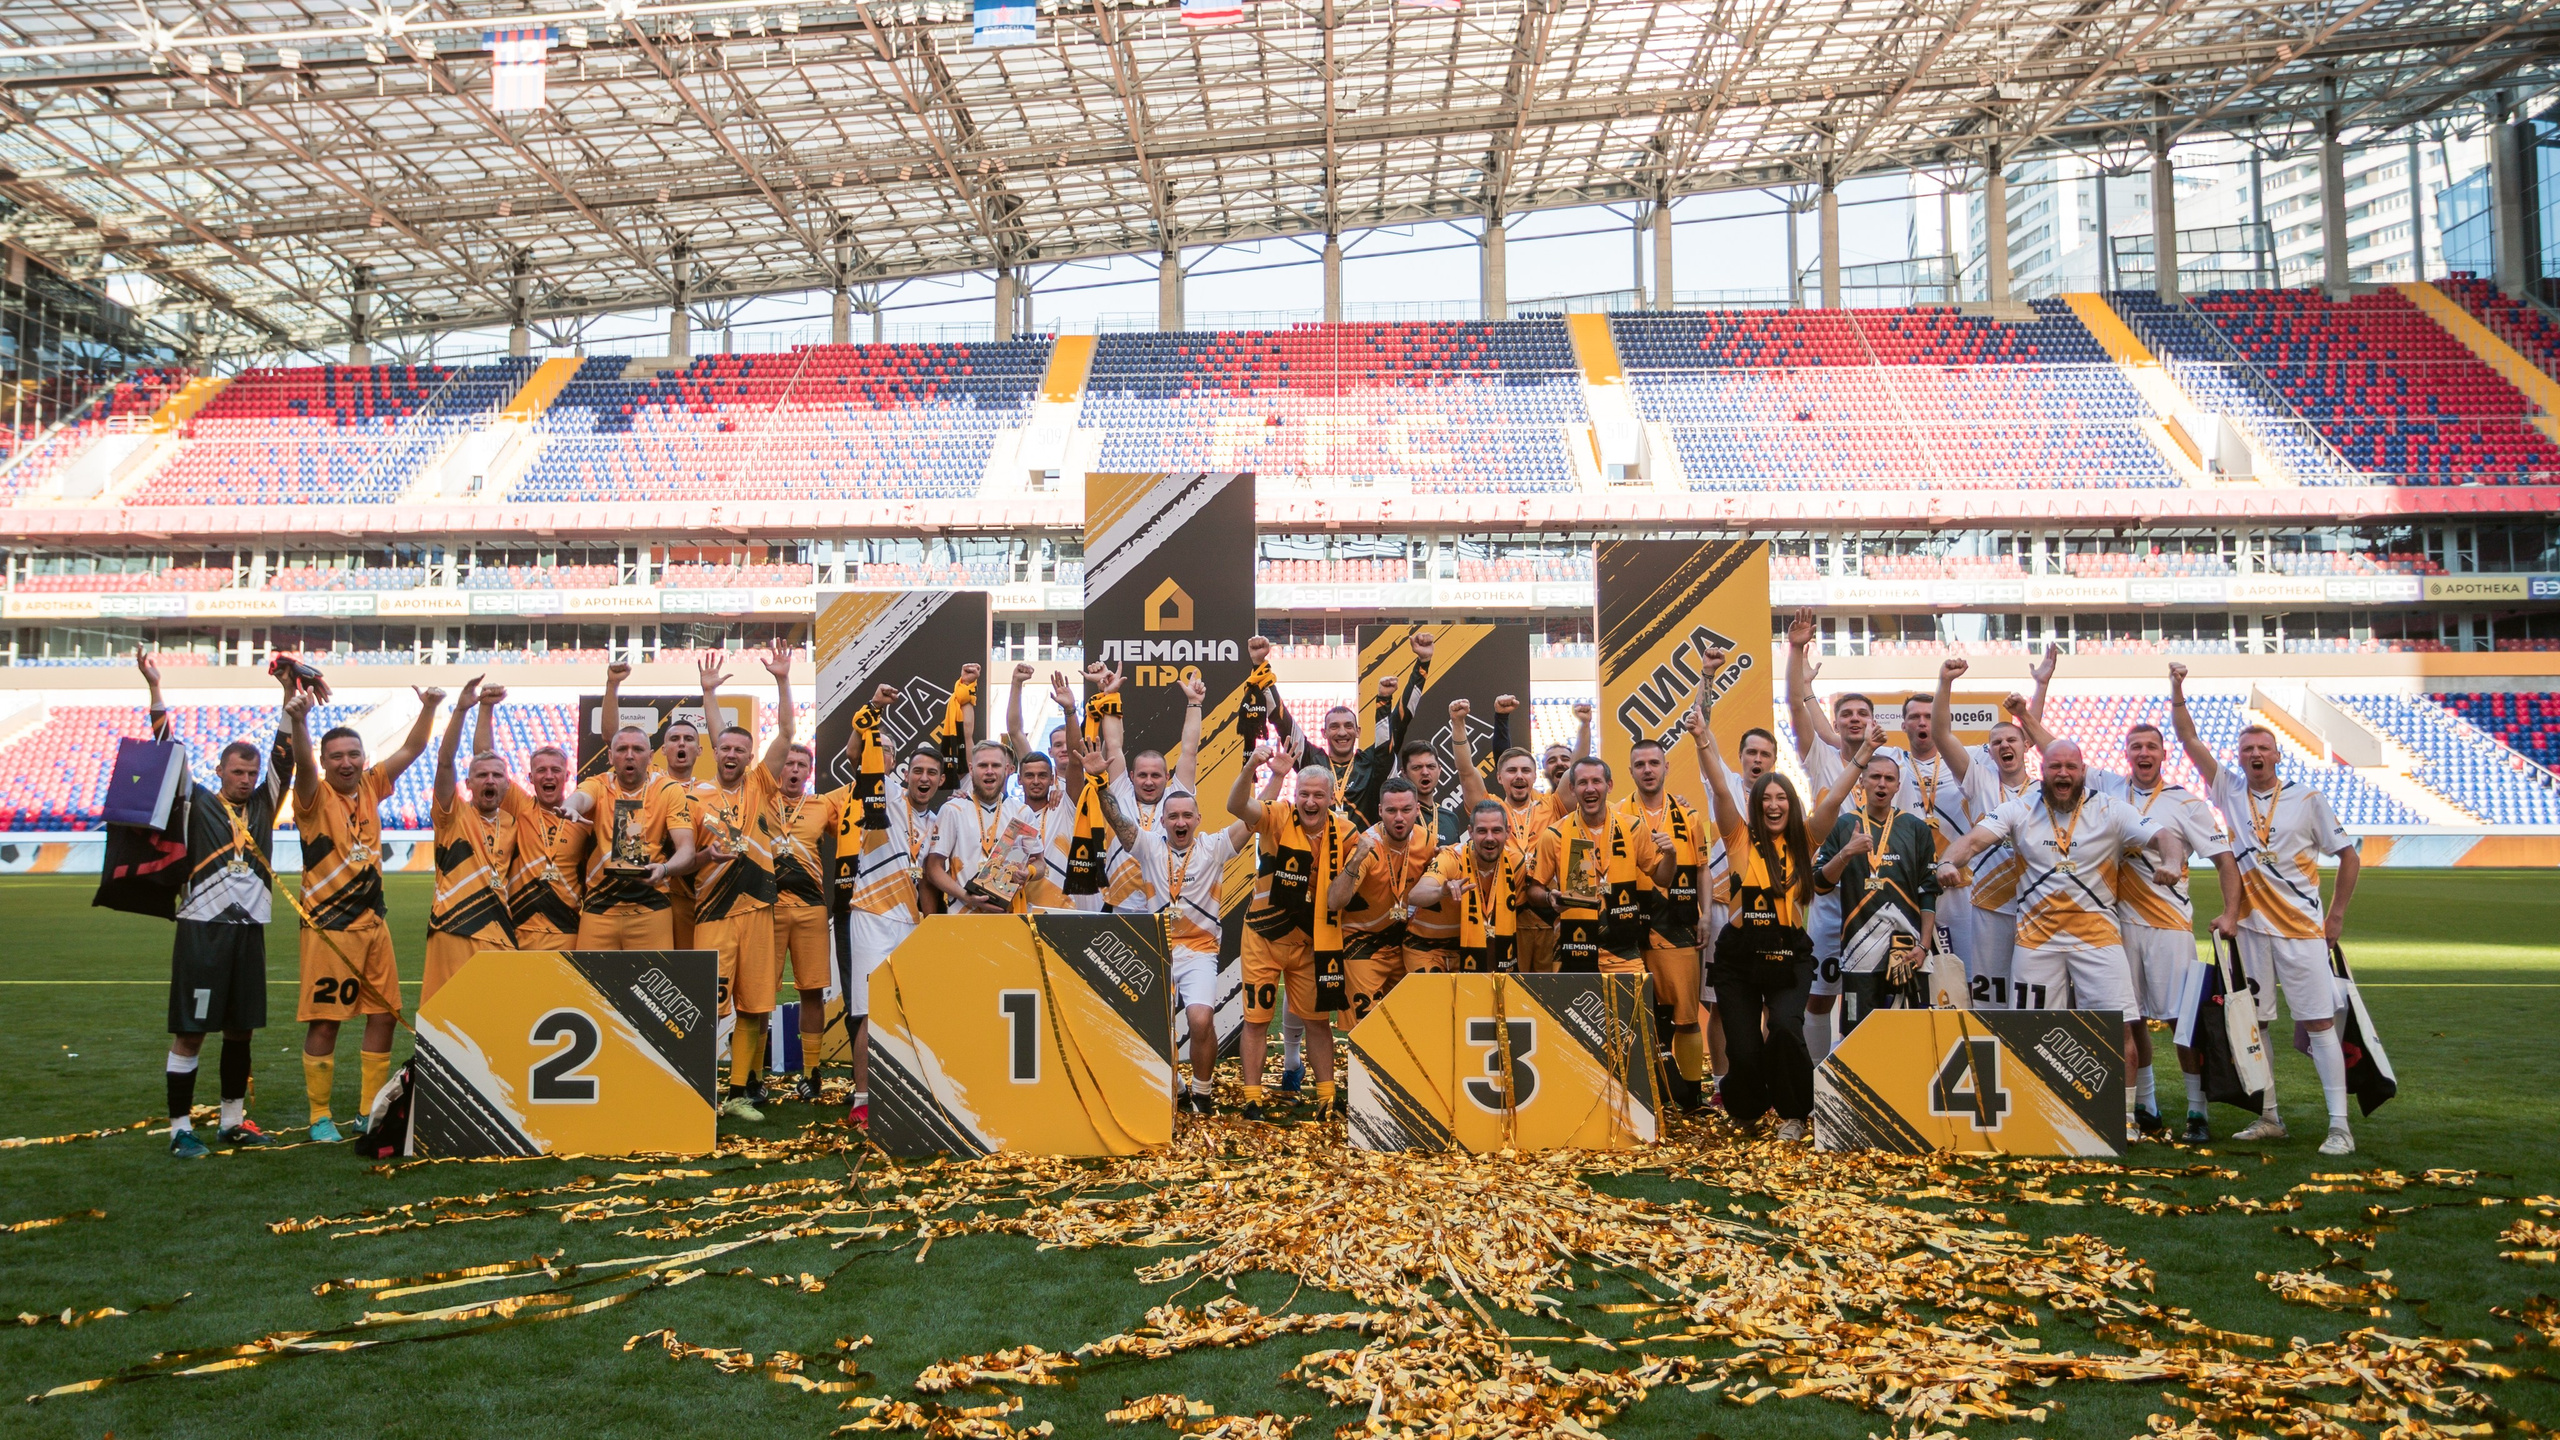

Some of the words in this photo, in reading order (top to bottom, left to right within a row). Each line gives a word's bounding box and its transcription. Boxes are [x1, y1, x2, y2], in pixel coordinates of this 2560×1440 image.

[775, 596, 816, 605] APOTH
[993, 595, 1036, 604] THEKA
[1453, 590, 1524, 600] APOTHEKA
[1849, 589, 1920, 598] APOTHEKA
[2047, 587, 2118, 597] APOTHEKA
[2249, 585, 2321, 596] APOTHEKA
[2446, 583, 2520, 594] APOTHEKA
[25, 601, 93, 611] APOTHEKA
[209, 600, 277, 610] APOTHEKA
[394, 598, 462, 608] APOTHEKA
[584, 597, 653, 607] APOTHEKA
[1099, 639, 1239, 662] ЛЕМАНА
[1136, 665, 1202, 687] ПРО
[1616, 623, 1738, 744] ЛИГА
[1714, 653, 1754, 693] ПРО
[620, 713, 646, 721] билайн
[1073, 866, 1089, 874] ПРО
[1274, 870, 1307, 882] ЛЕМАНА
[1669, 887, 1696, 895] ЛЕМАНА
[1610, 904, 1638, 915] ЛЕМАНА
[1562, 943, 1597, 951] ЛЕМАНА
[1082, 946, 1122, 986] ЛЕМАНА
[1119, 982, 1139, 1003] ПРО
[1090, 930, 1155, 995] ЛИГА
[313, 976, 360, 1006] 20
[638, 967, 702, 1032] ЛИГА
[1245, 983, 1276, 1009] 10
[1972, 974, 2006, 1004] 21
[2014, 981, 2046, 1009] 11
[193, 988, 212, 1019] 1
[629, 983, 667, 1023] ЛЕМАНА
[664, 1019, 685, 1040] ПРО
[1564, 1006, 1604, 1046] ЛЕМАНА
[1571, 990, 1637, 1056] ЛИГА
[999, 988, 1041, 1085] 1
[528, 1007, 602, 1104] 2
[1462, 1016, 1540, 1114] 3
[2041, 1027, 2109, 1093] ЛИГА
[1928, 1035, 2012, 1132] 4
[2033, 1043, 2074, 1083] ЛЕМАНА
[2071, 1079, 2094, 1101] ПРО
